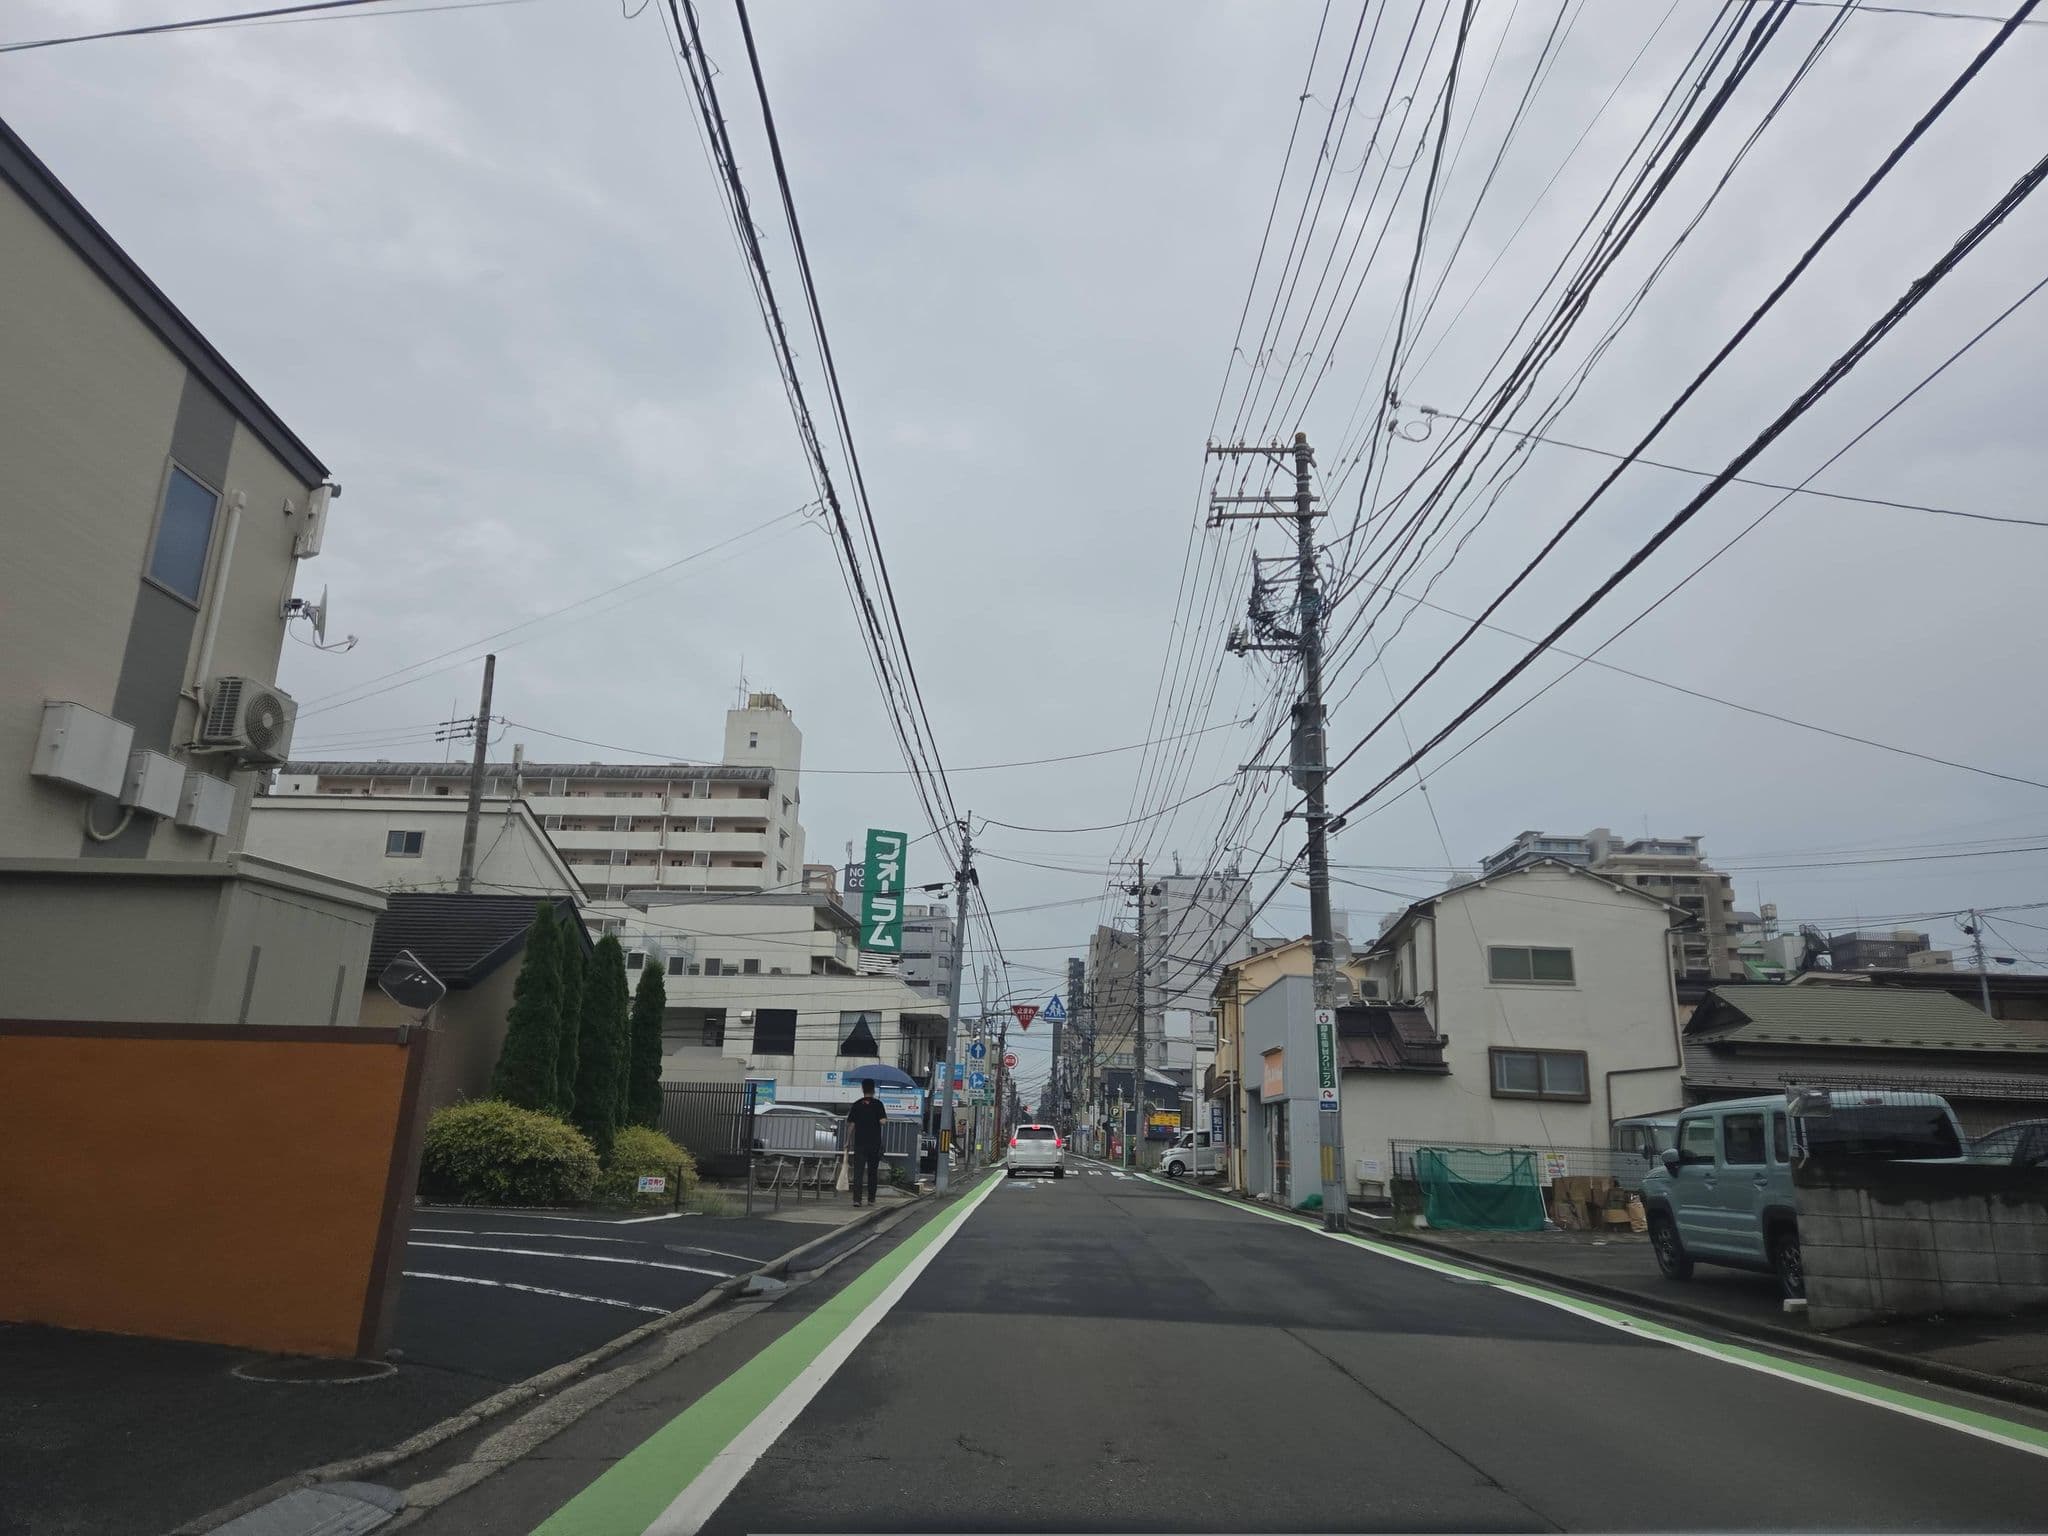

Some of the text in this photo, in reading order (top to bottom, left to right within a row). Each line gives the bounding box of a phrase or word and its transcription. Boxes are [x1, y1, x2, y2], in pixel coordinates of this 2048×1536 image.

[868, 836, 901, 947] フォーラム
